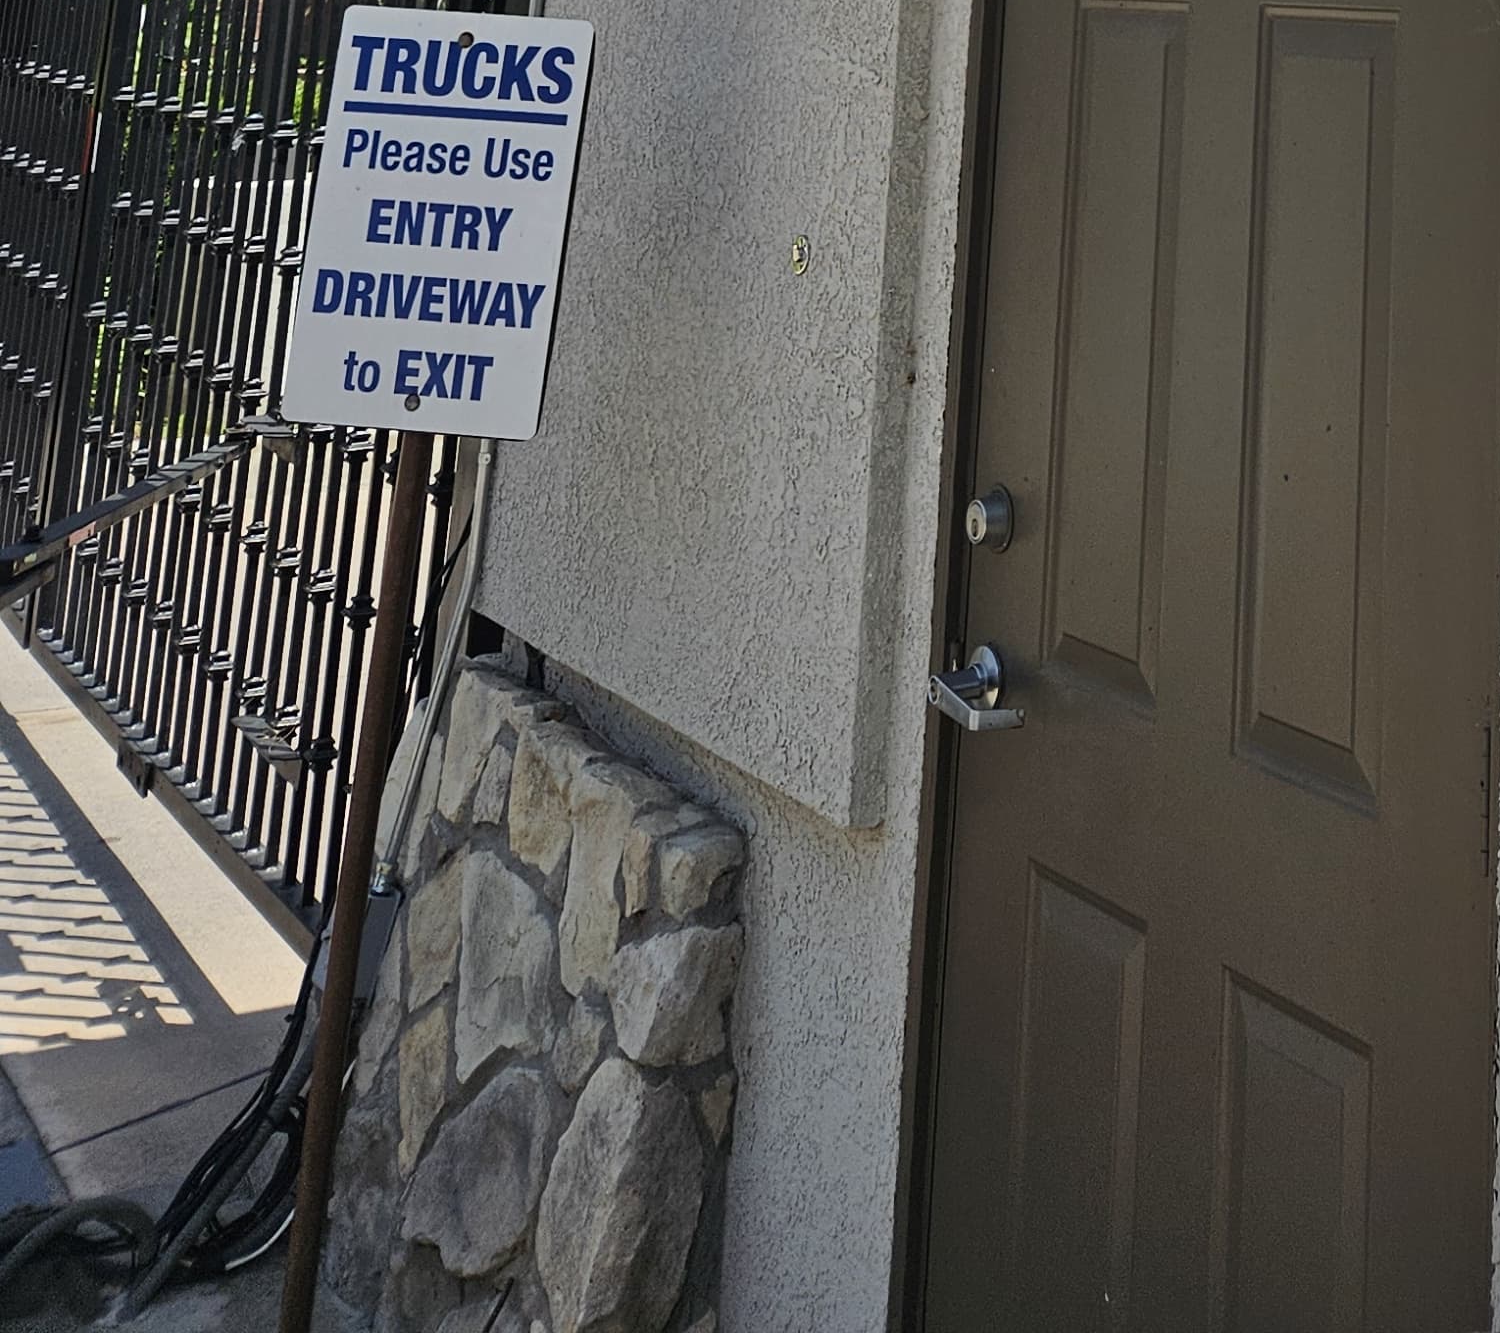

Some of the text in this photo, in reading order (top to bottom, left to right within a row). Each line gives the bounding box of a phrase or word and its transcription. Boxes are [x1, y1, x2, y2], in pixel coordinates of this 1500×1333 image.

[352, 36, 575, 103] TRUCKS
[343, 129, 554, 181] Please Use
[366, 199, 513, 251] ENTRY
[312, 269, 546, 329] DRIVEWAY
[344, 349, 494, 401] to EXIT
